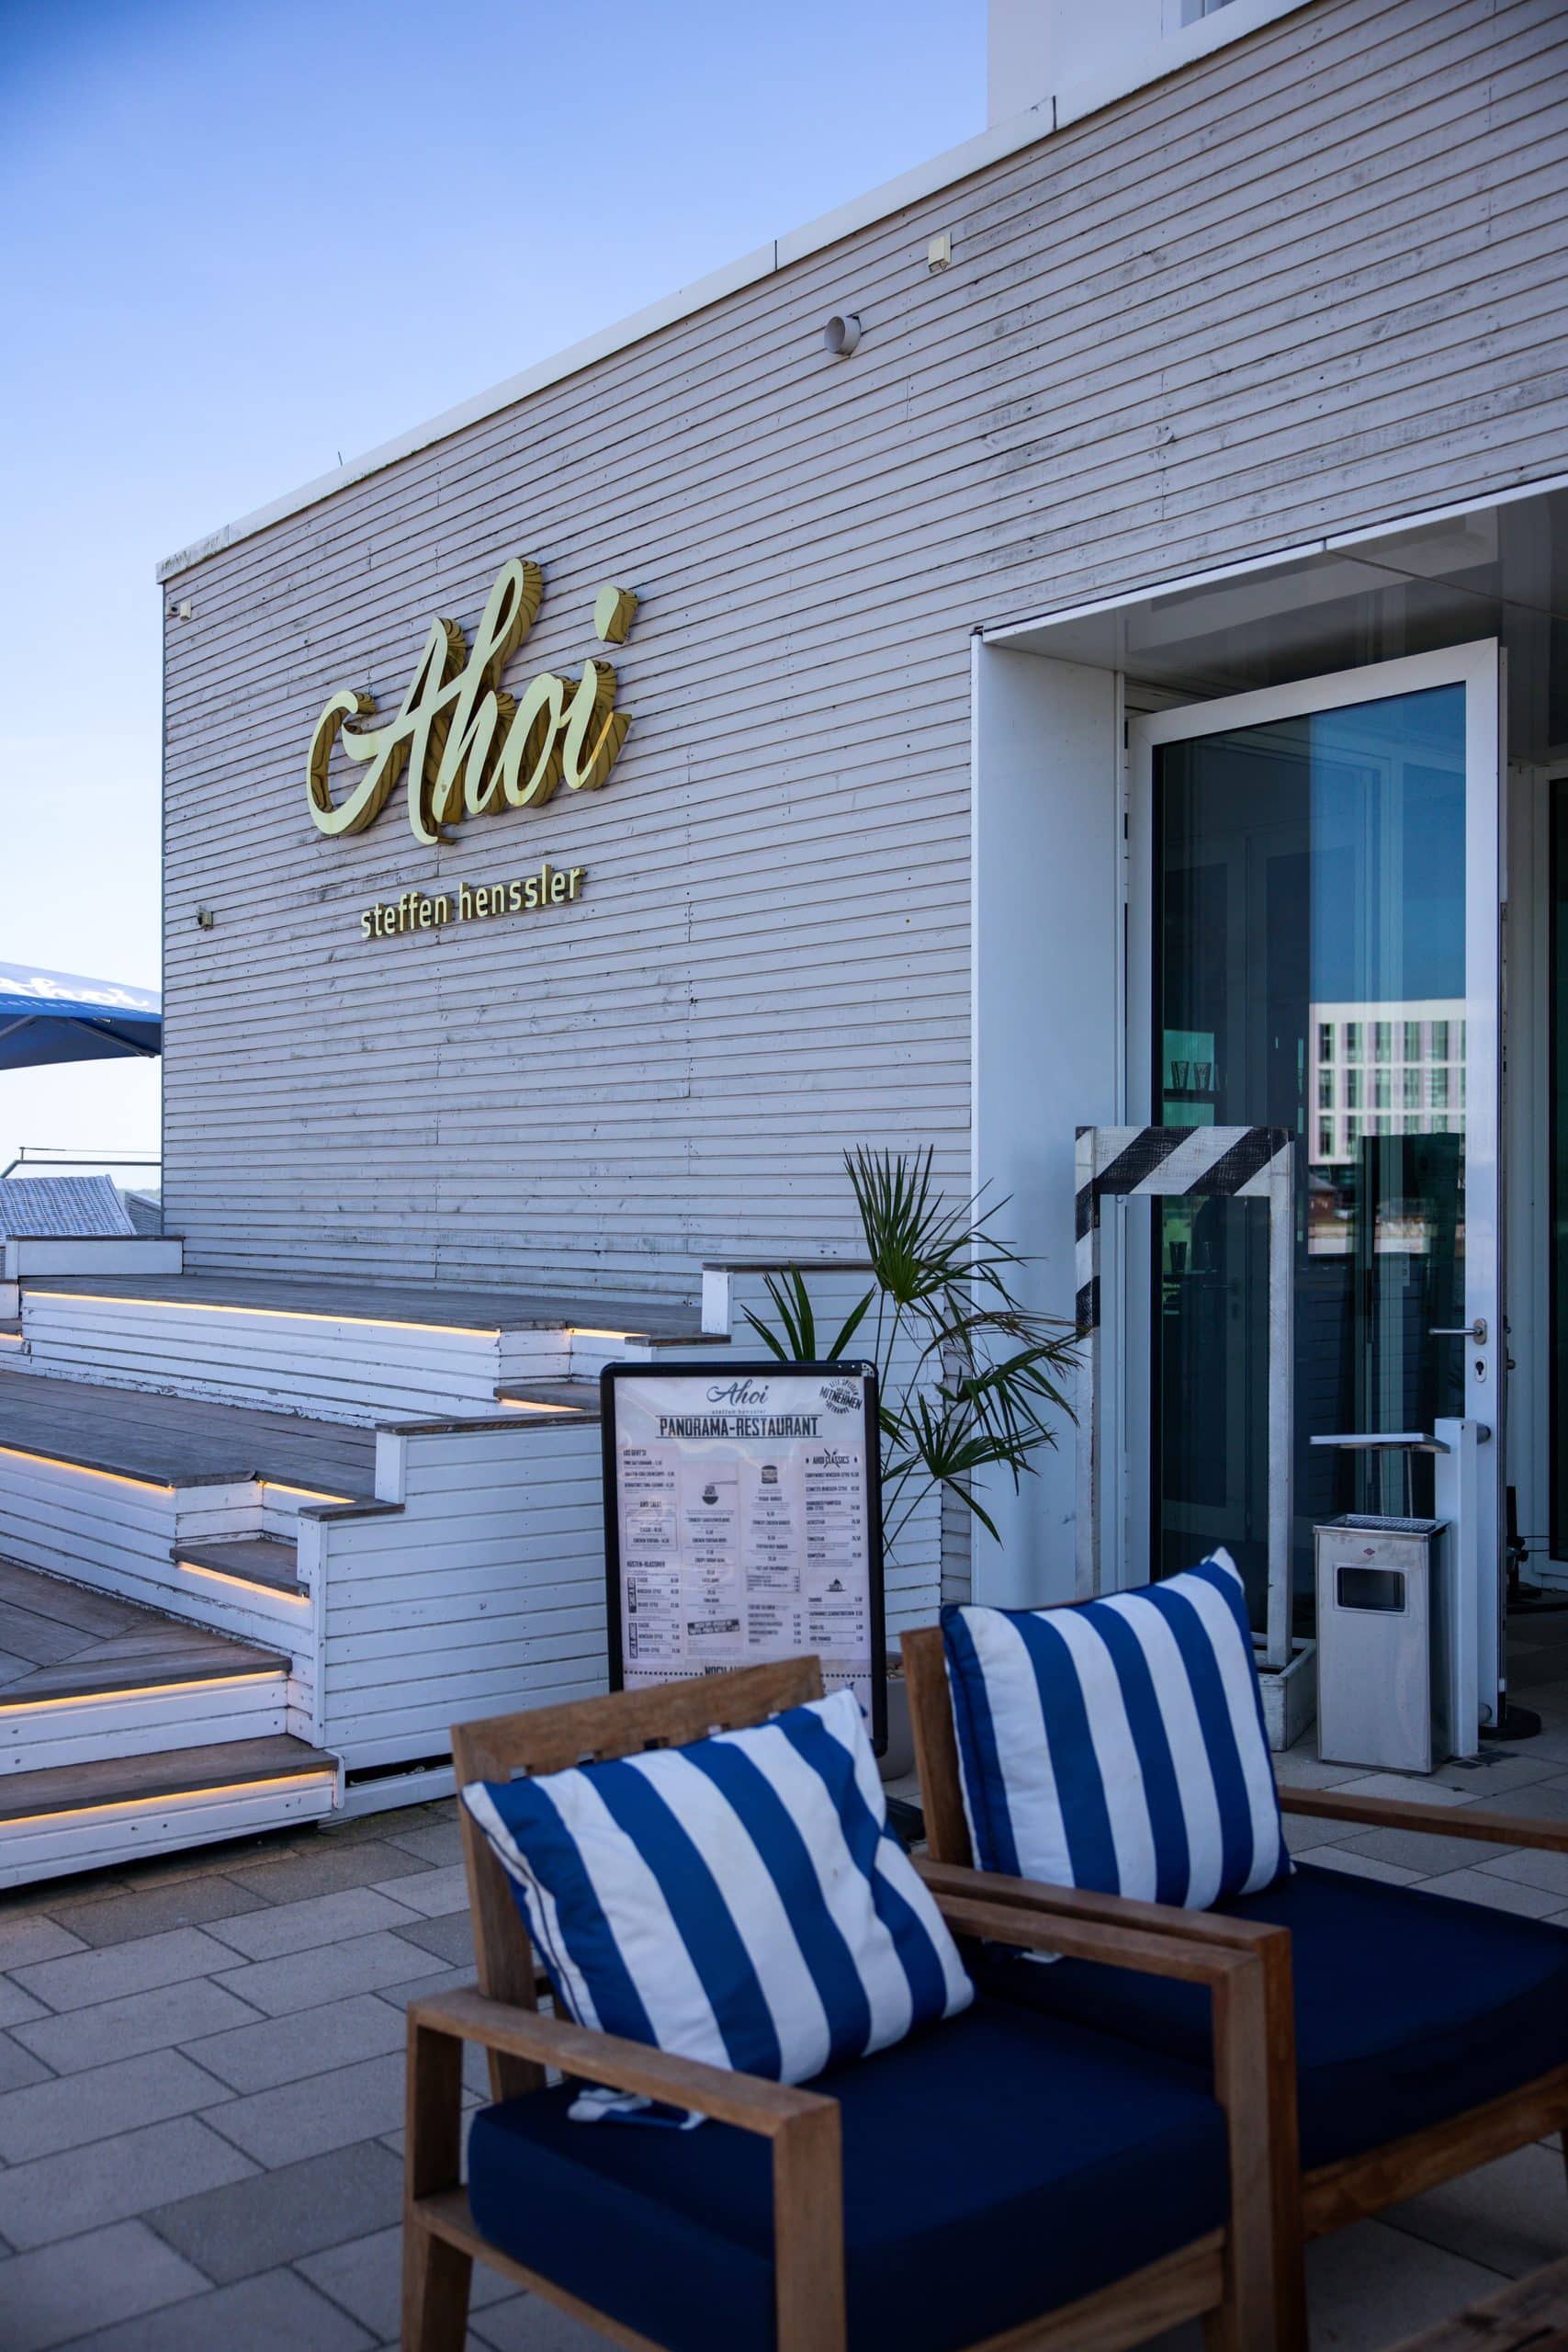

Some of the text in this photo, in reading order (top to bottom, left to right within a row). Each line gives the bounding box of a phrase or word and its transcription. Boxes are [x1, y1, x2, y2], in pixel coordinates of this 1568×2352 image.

[306, 558, 638, 845] Ahoi
[360, 864, 586, 938] steffen henssler
[706, 1378, 769, 1406] Ahoi
[819, 1386, 863, 1411] MITNEHMEN
[660, 1416, 818, 1437] PANORAMA-RESTAURANT
